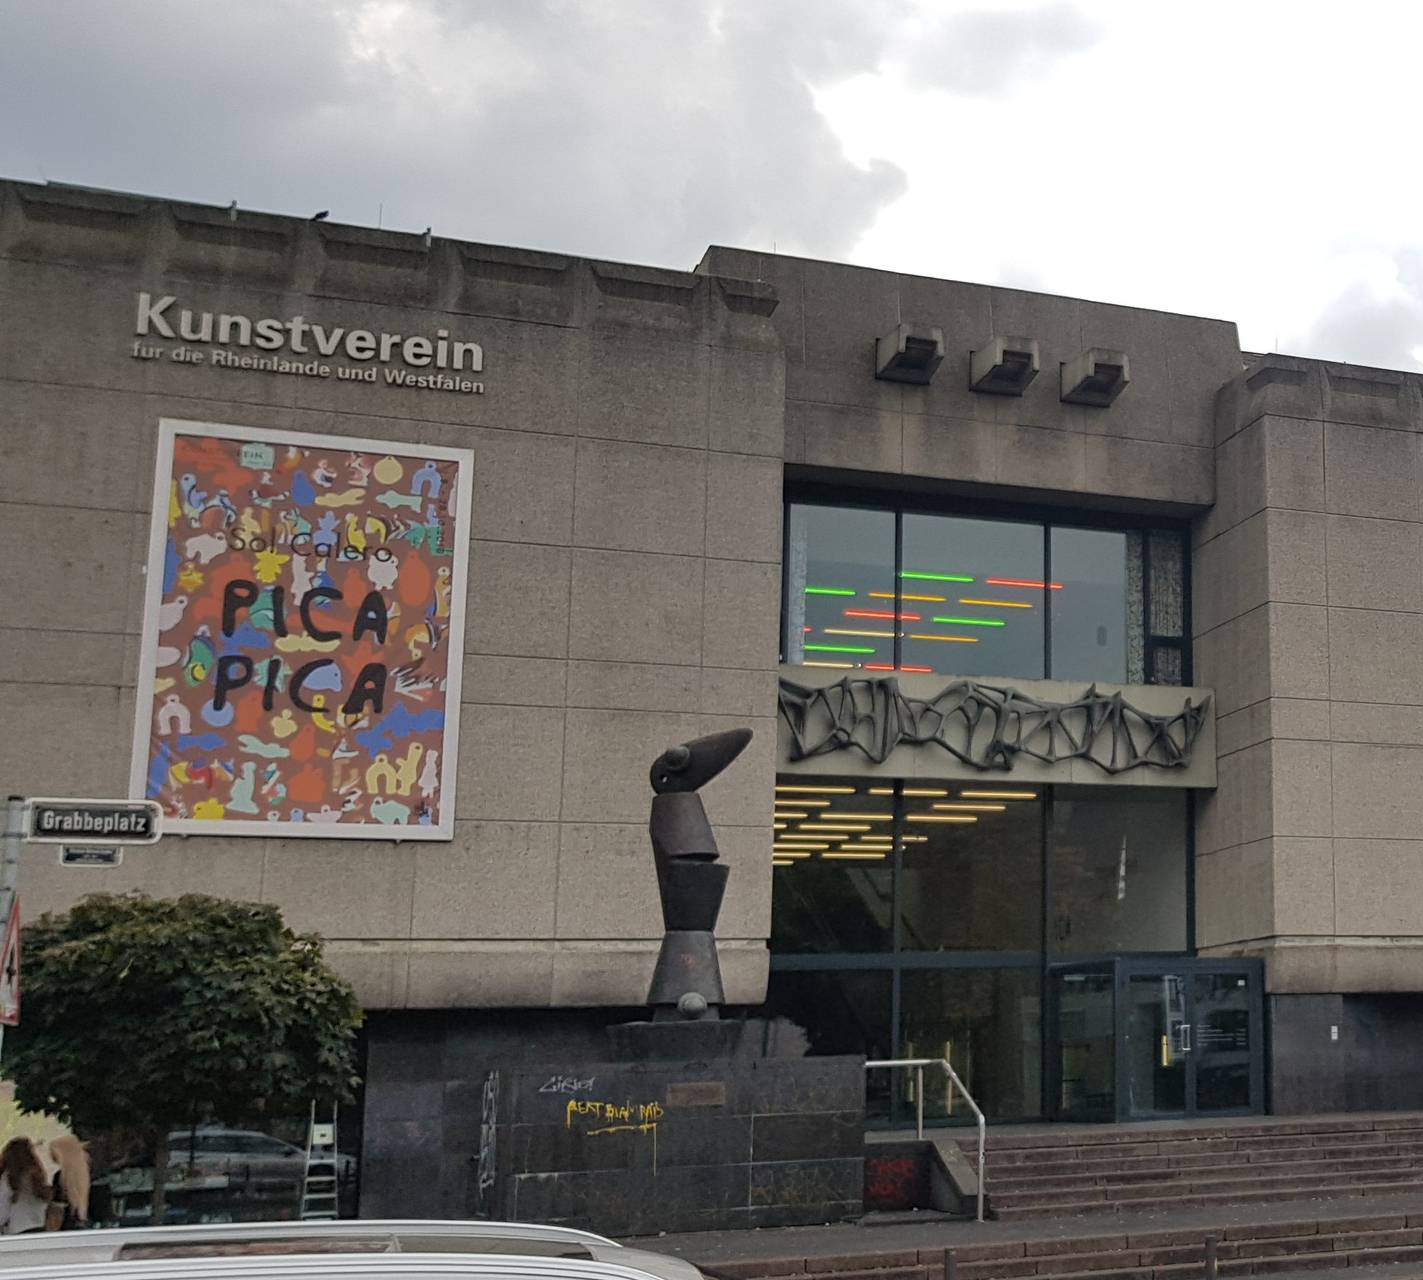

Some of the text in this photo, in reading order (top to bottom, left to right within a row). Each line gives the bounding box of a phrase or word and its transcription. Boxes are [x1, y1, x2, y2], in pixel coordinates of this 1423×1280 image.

[135, 292, 484, 372] Kunstverein
[172, 346, 204, 364] die
[211, 348, 331, 378] Rheinlande
[338, 366, 377, 383] und
[385, 368, 485, 395] Westfalen
[291, 532, 393, 563] Calero
[221, 579, 388, 645] PICA
[212, 654, 388, 714] PICA
[43, 811, 147, 834] Grabbeplatz
